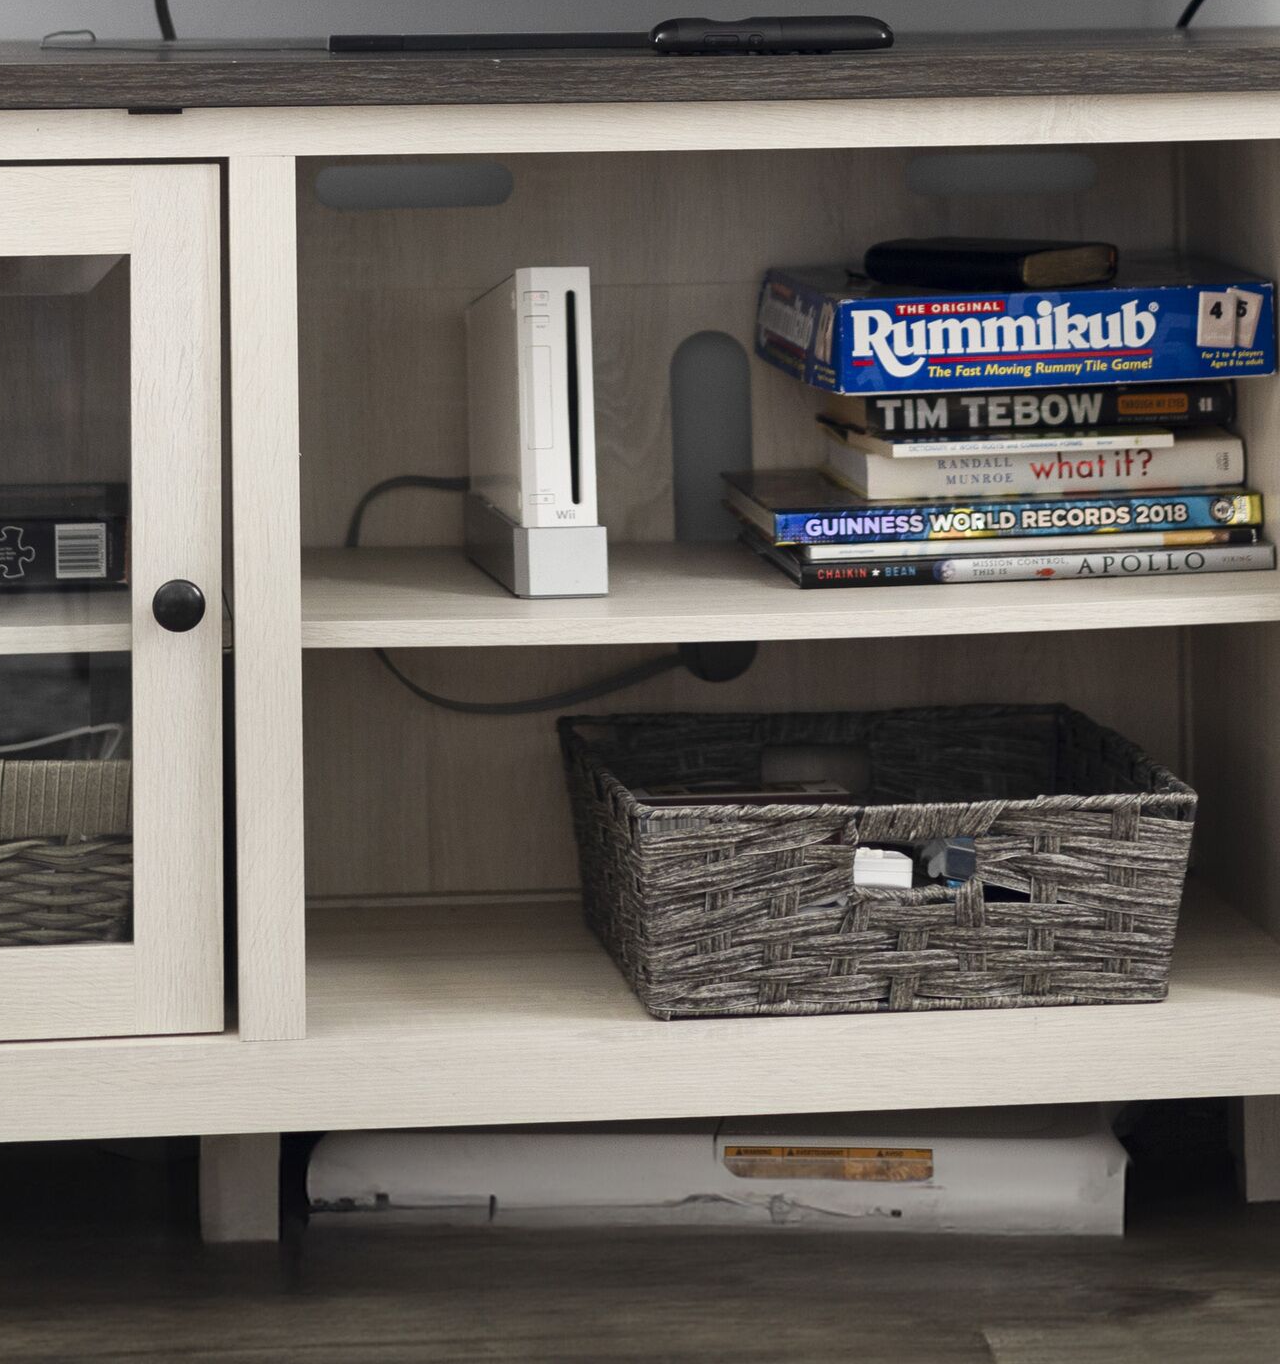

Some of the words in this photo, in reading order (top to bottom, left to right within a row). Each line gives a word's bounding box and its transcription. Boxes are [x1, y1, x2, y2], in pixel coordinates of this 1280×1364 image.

[898, 304, 925, 314] THE
[931, 301, 1000, 312] ORIGINAL
[1209, 301, 1223, 319] 4
[851, 300, 1157, 377] Rummikub
[928, 365, 951, 377] The
[955, 364, 981, 376] Fast
[984, 362, 1032, 377] Moving
[1035, 359, 1082, 375] Rummy
[1084, 358, 1108, 372] Tile
[1111, 357, 1153, 371] Game!
[876, 398, 948, 430] TIM
[960, 392, 1103, 428] TEBOW
[937, 457, 1013, 470] RANDALL
[1030, 452, 1105, 479] what
[946, 473, 1014, 485] MUNROE
[556, 509, 575, 519] Wii
[805, 515, 923, 536] GUINNESS
[929, 511, 1016, 532] WORLD
[1021, 507, 1130, 528] RECORDS
[1136, 504, 1188, 524] 2018
[972, 568, 995, 576] THIS
[1076, 552, 1206, 575] APOLLO
[817, 567, 868, 580] CHAIKIN
[884, 566, 916, 578] BEAN
